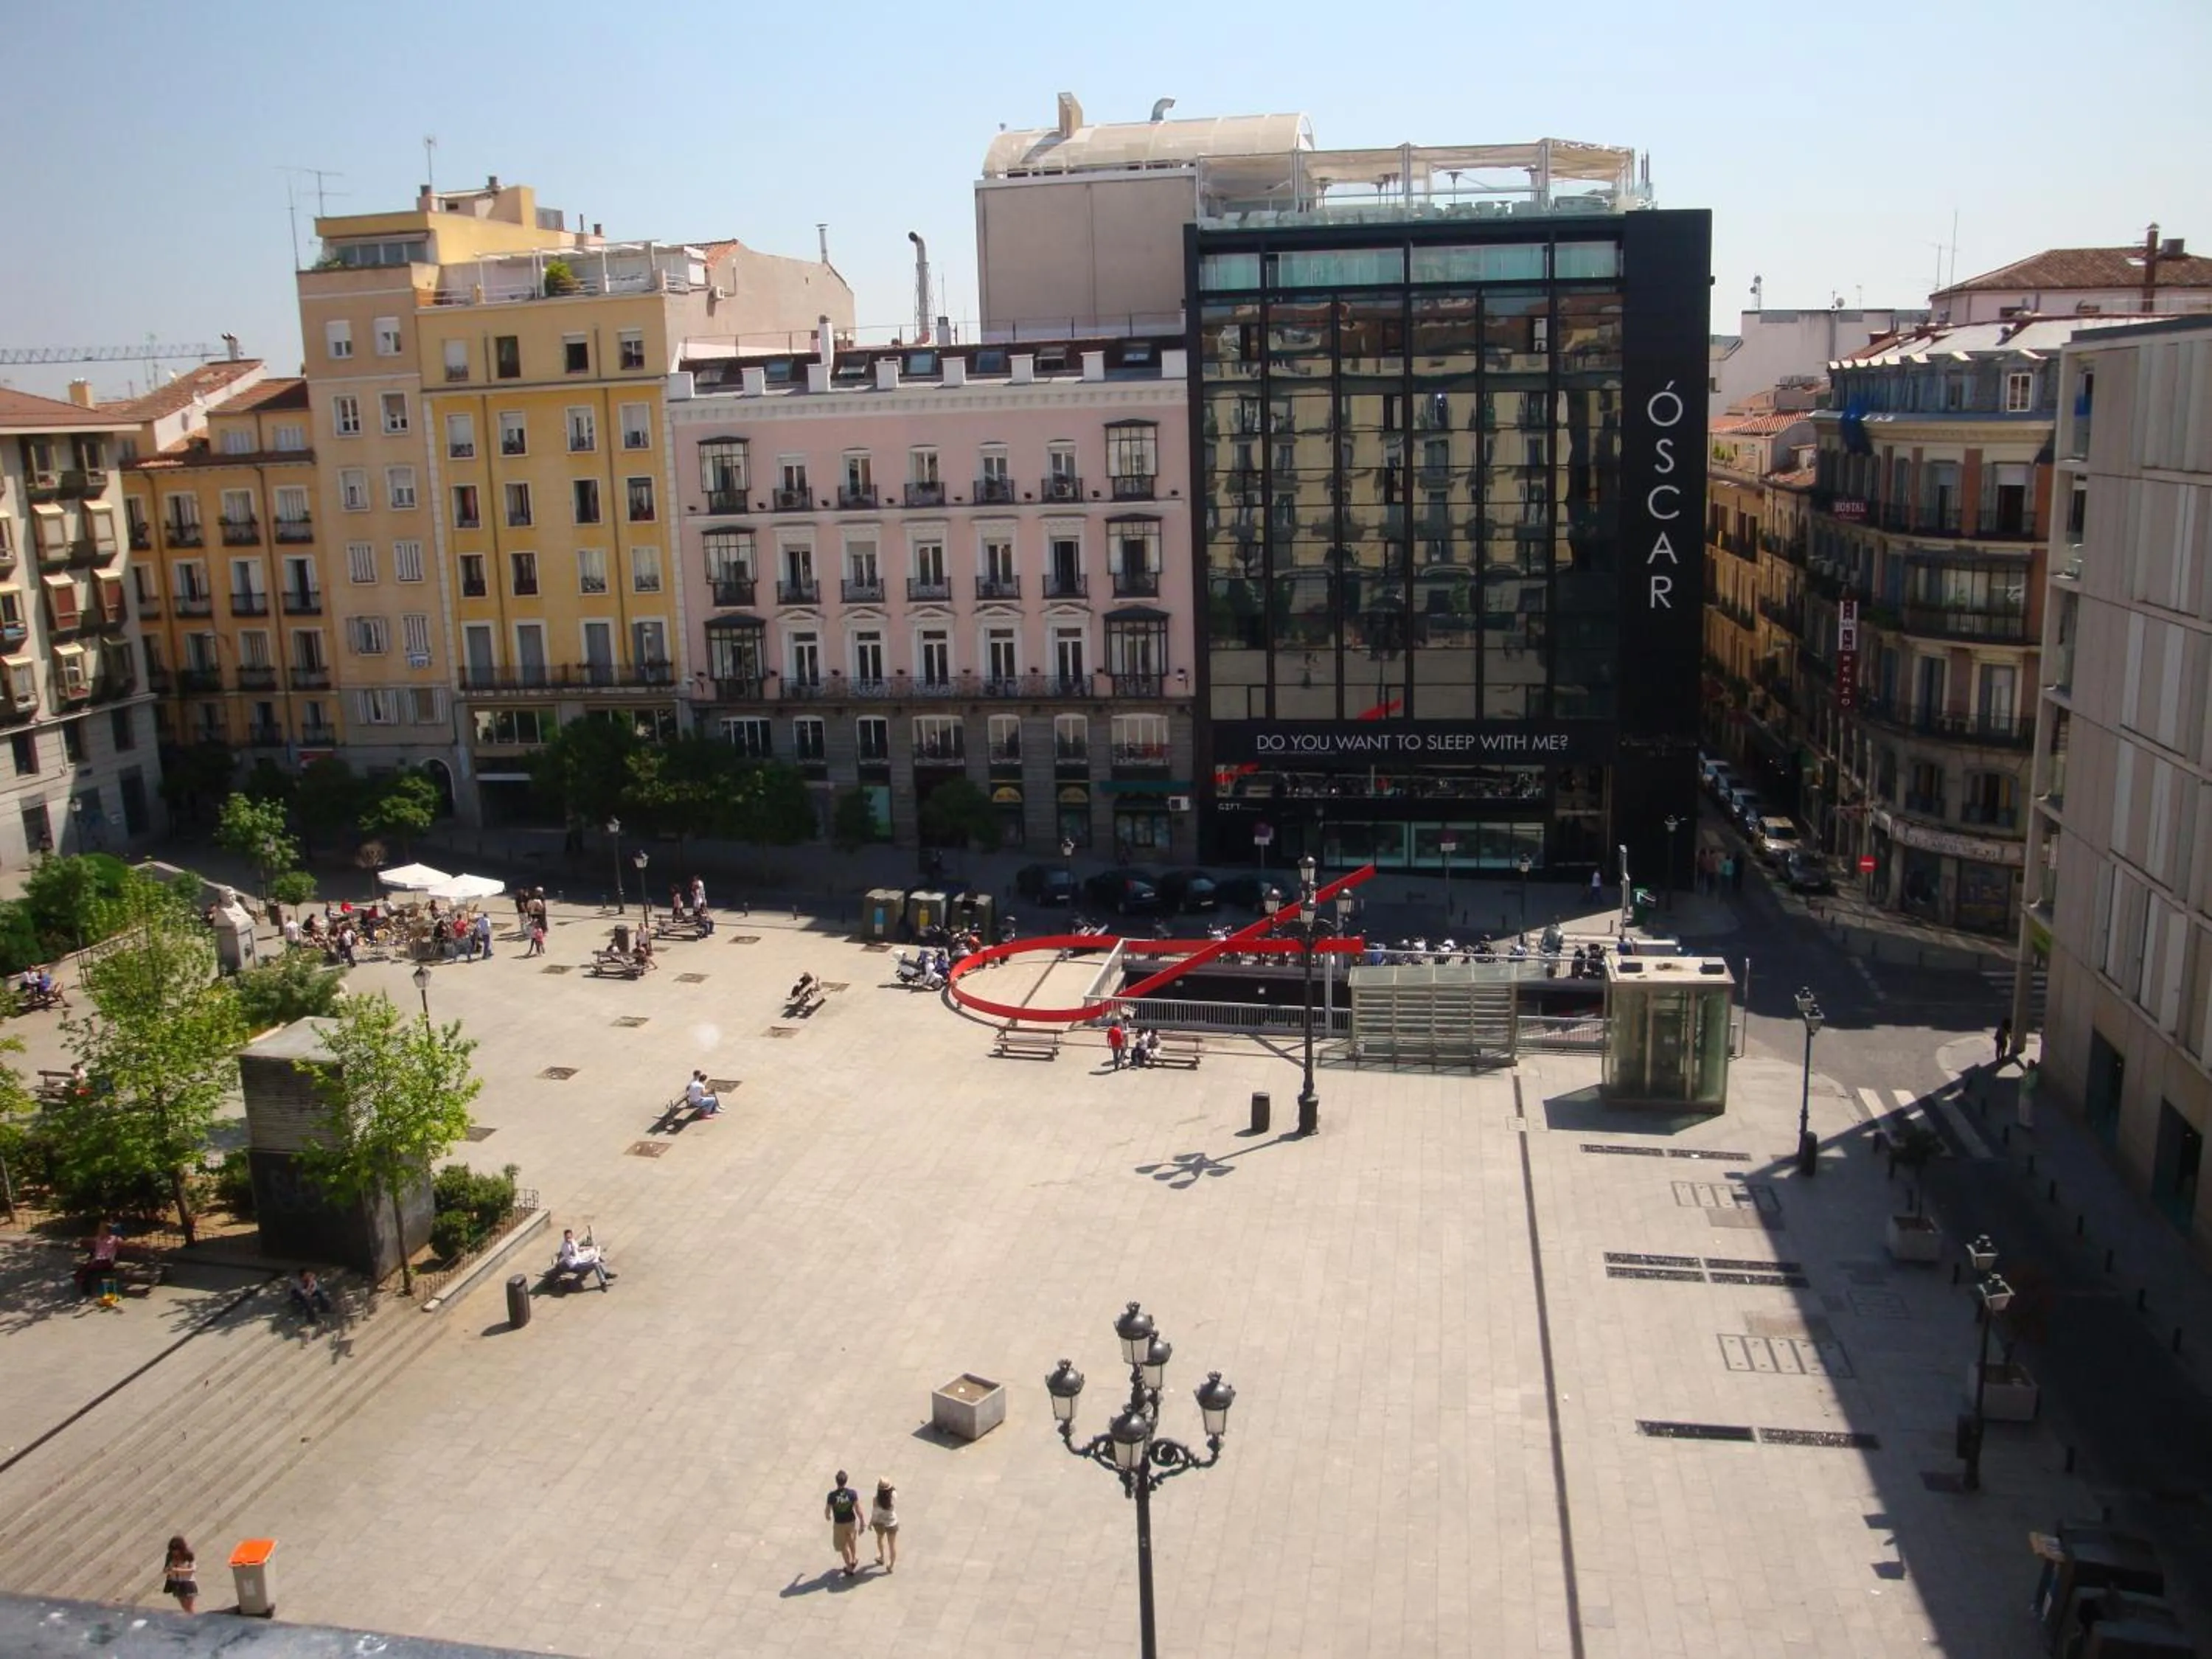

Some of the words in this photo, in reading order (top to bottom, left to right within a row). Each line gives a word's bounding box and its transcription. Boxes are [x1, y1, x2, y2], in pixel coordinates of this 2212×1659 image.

[1647, 380, 1683, 609] ÓSCAR
[1834, 501, 1864, 512] HOSTAL
[1256, 734, 1285, 750] DO
[1290, 734, 1330, 750] YOU
[1335, 734, 1391, 750] WANT
[1395, 734, 1422, 750] TO
[1427, 734, 1475, 750] SLEEP
[1480, 734, 1527, 750] WITH
[1531, 734, 1569, 750] ME?
